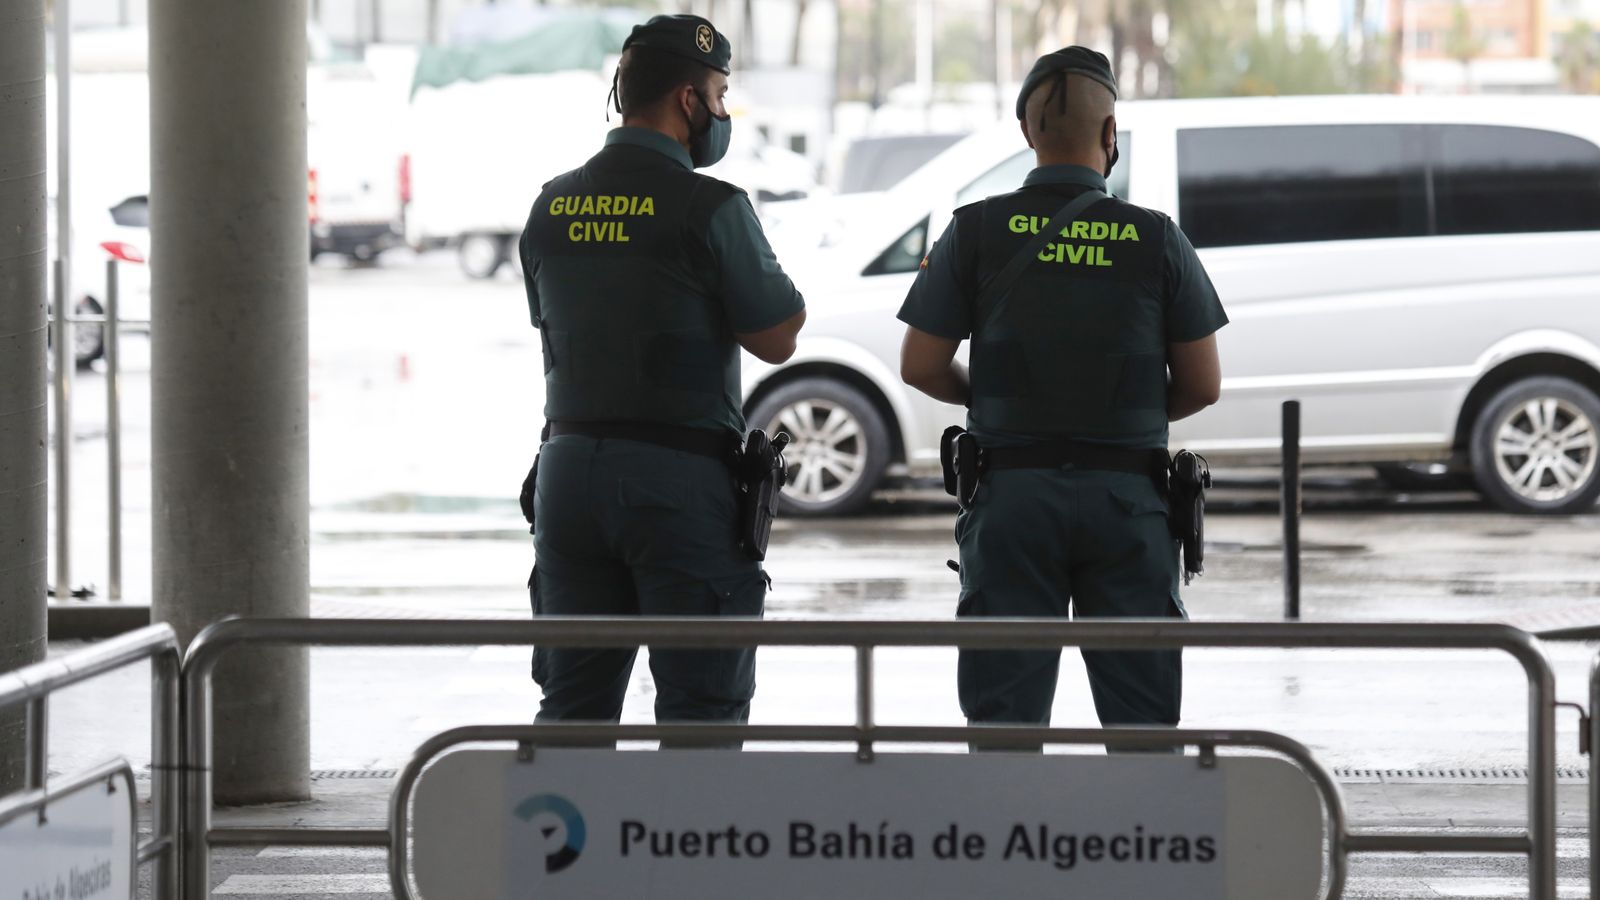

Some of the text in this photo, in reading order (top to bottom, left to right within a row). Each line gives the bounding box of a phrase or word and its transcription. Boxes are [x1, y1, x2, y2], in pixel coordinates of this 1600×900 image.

[549, 195, 655, 216] GUARDIA
[568, 221, 630, 242] CIVIL
[1037, 242, 1113, 267] CIVIL
[619, 820, 1218, 871] Puerto Bahía de Algeciras
